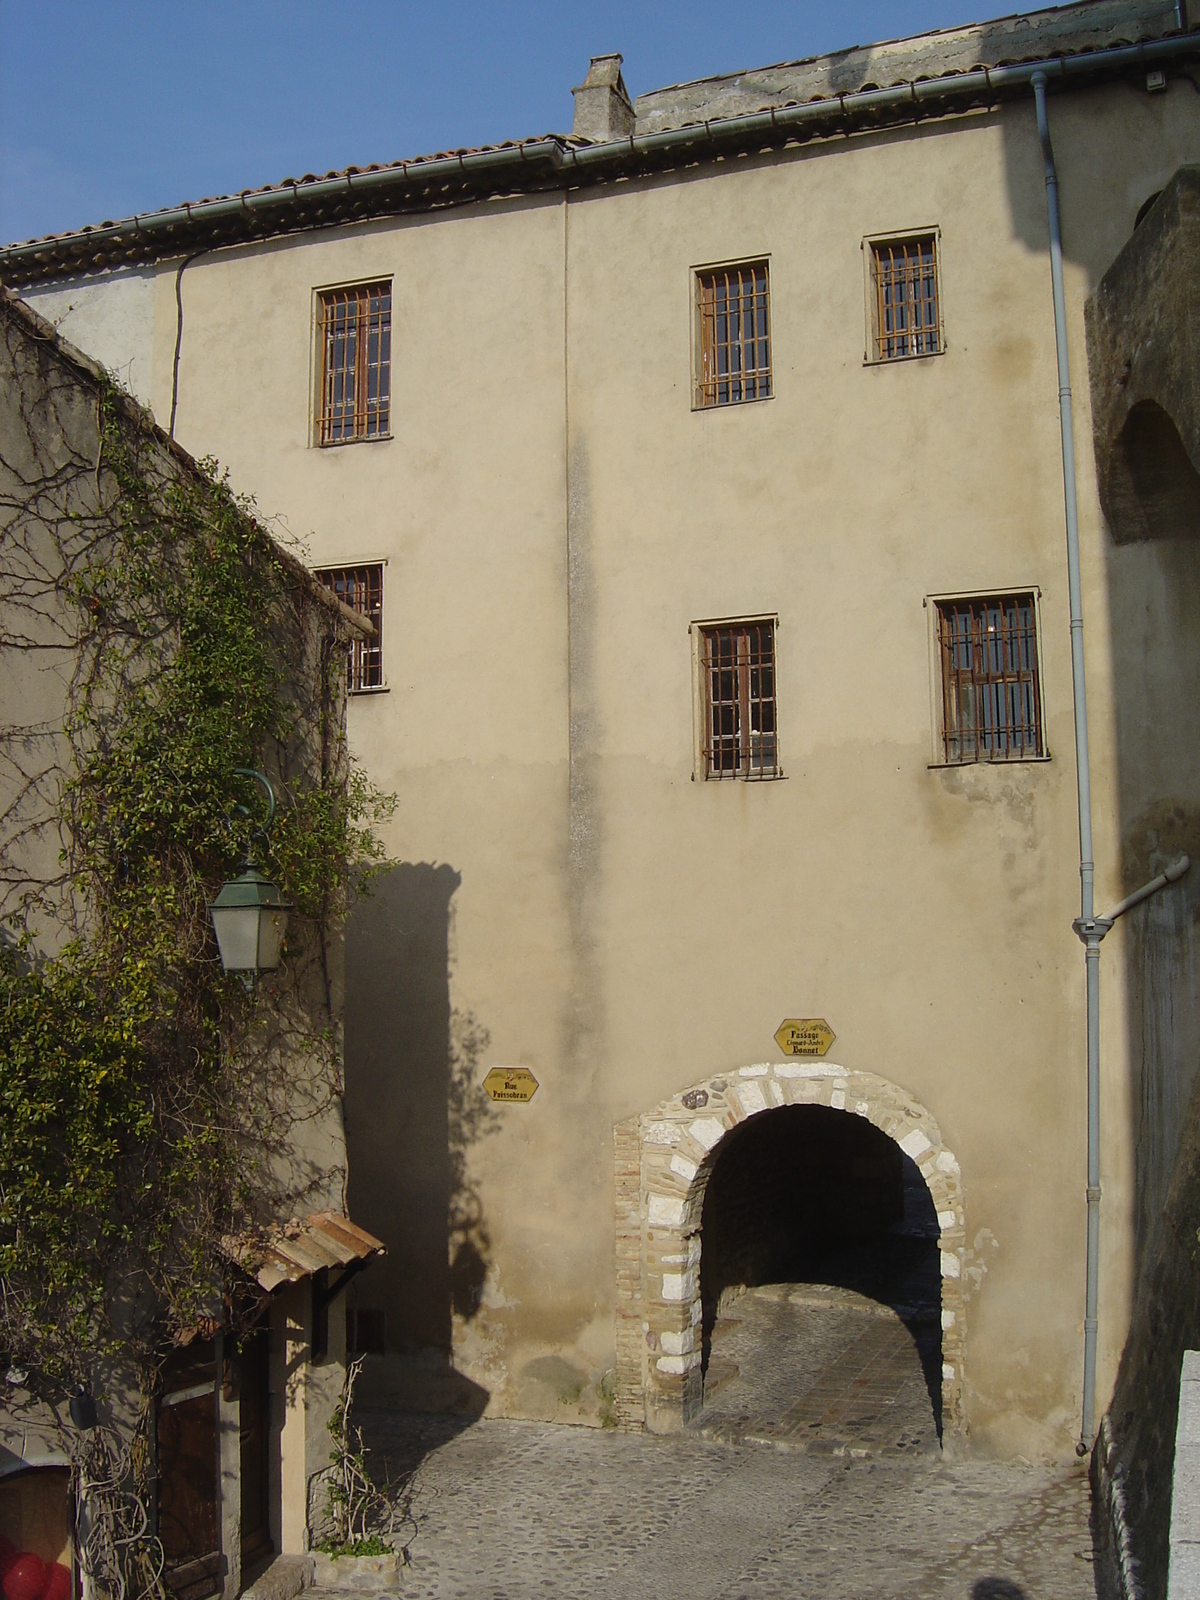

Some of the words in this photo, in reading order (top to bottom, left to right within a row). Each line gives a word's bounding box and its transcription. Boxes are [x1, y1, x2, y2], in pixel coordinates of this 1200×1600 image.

[791, 1031, 819, 1040] Passage
[792, 1045, 819, 1054] Bonnet
[504, 1081, 518, 1090] Rue
